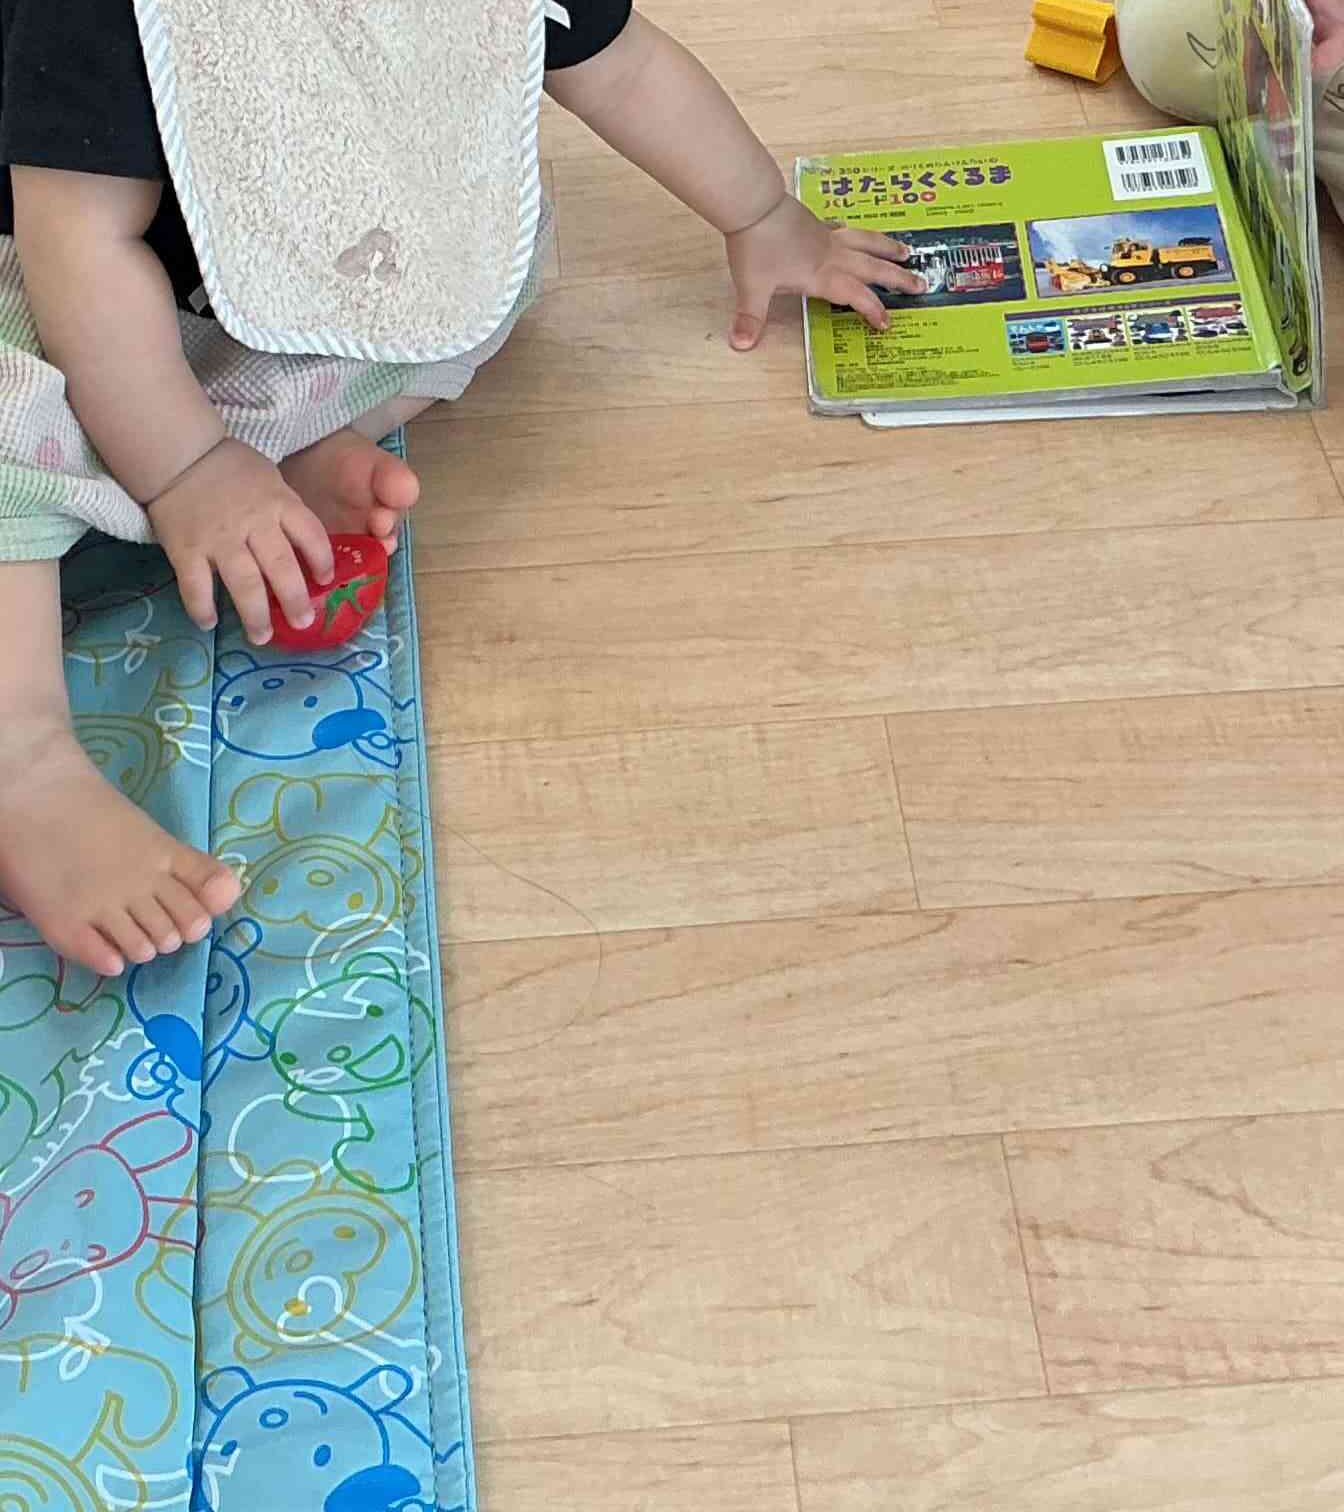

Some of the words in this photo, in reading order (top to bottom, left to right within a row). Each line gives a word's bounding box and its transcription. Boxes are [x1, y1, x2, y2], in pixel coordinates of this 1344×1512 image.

[821, 165, 1012, 196] はたらくくるま
[823, 190, 937, 209] パレード100
